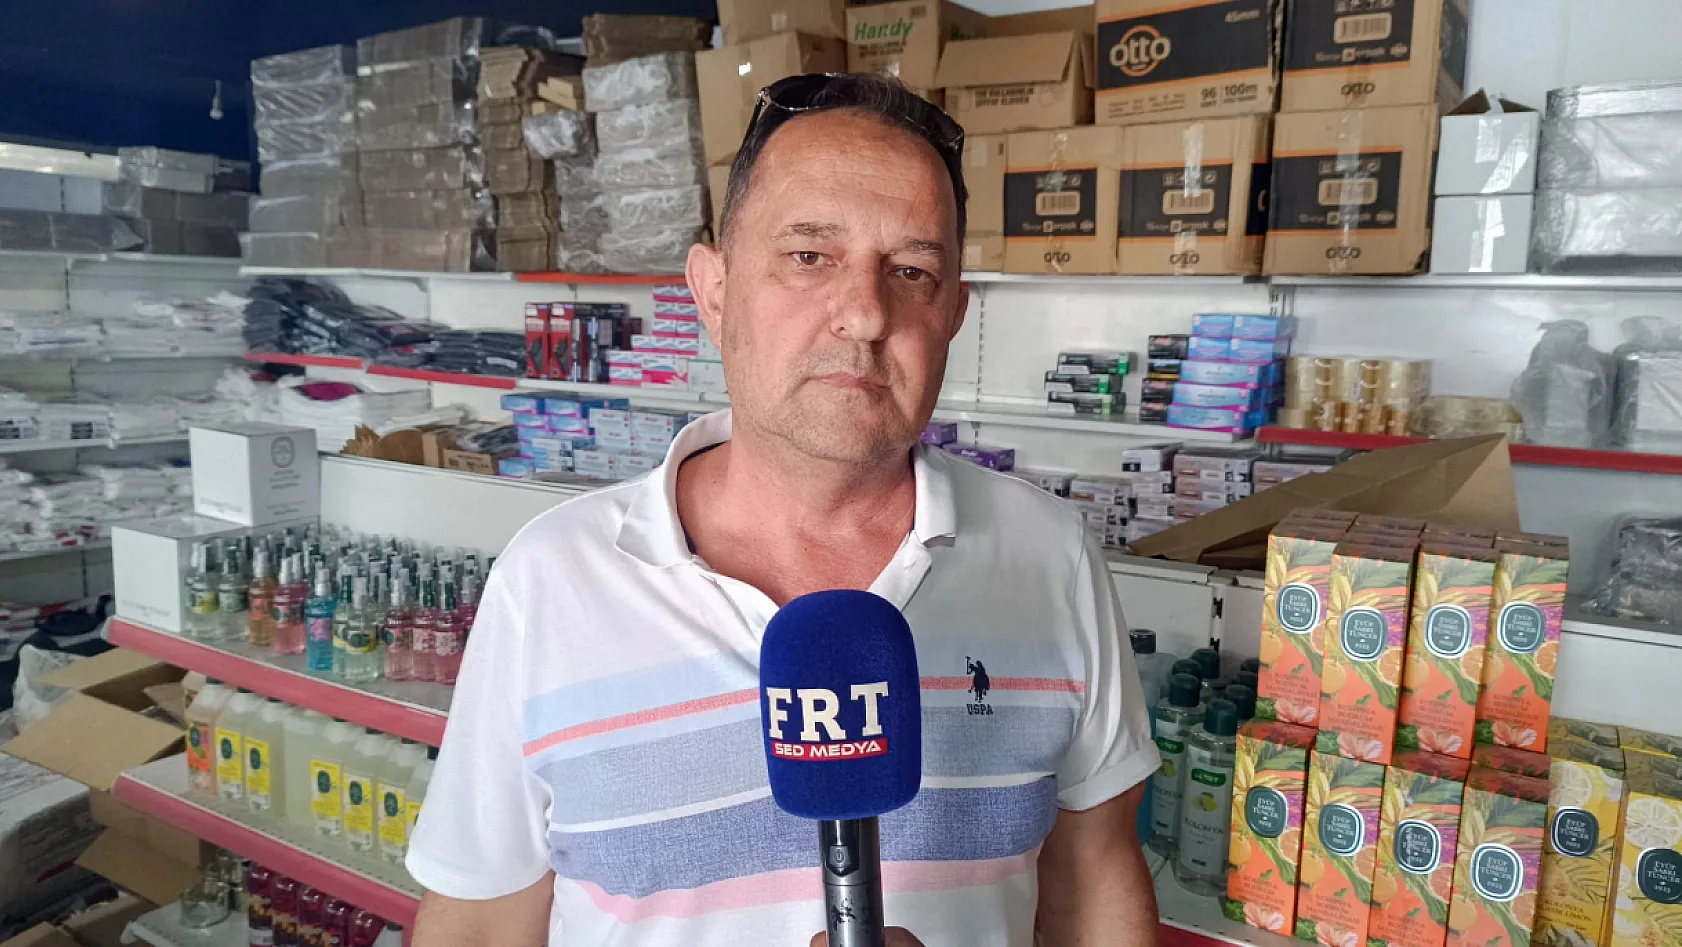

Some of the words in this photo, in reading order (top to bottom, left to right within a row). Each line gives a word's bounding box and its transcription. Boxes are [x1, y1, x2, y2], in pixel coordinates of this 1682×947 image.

[1110, 37, 1171, 66] otto
[766, 681, 888, 741] FRT
[966, 703, 994, 715] USPA
[775, 742, 804, 757] SED
[809, 740, 881, 758] MEDYA
